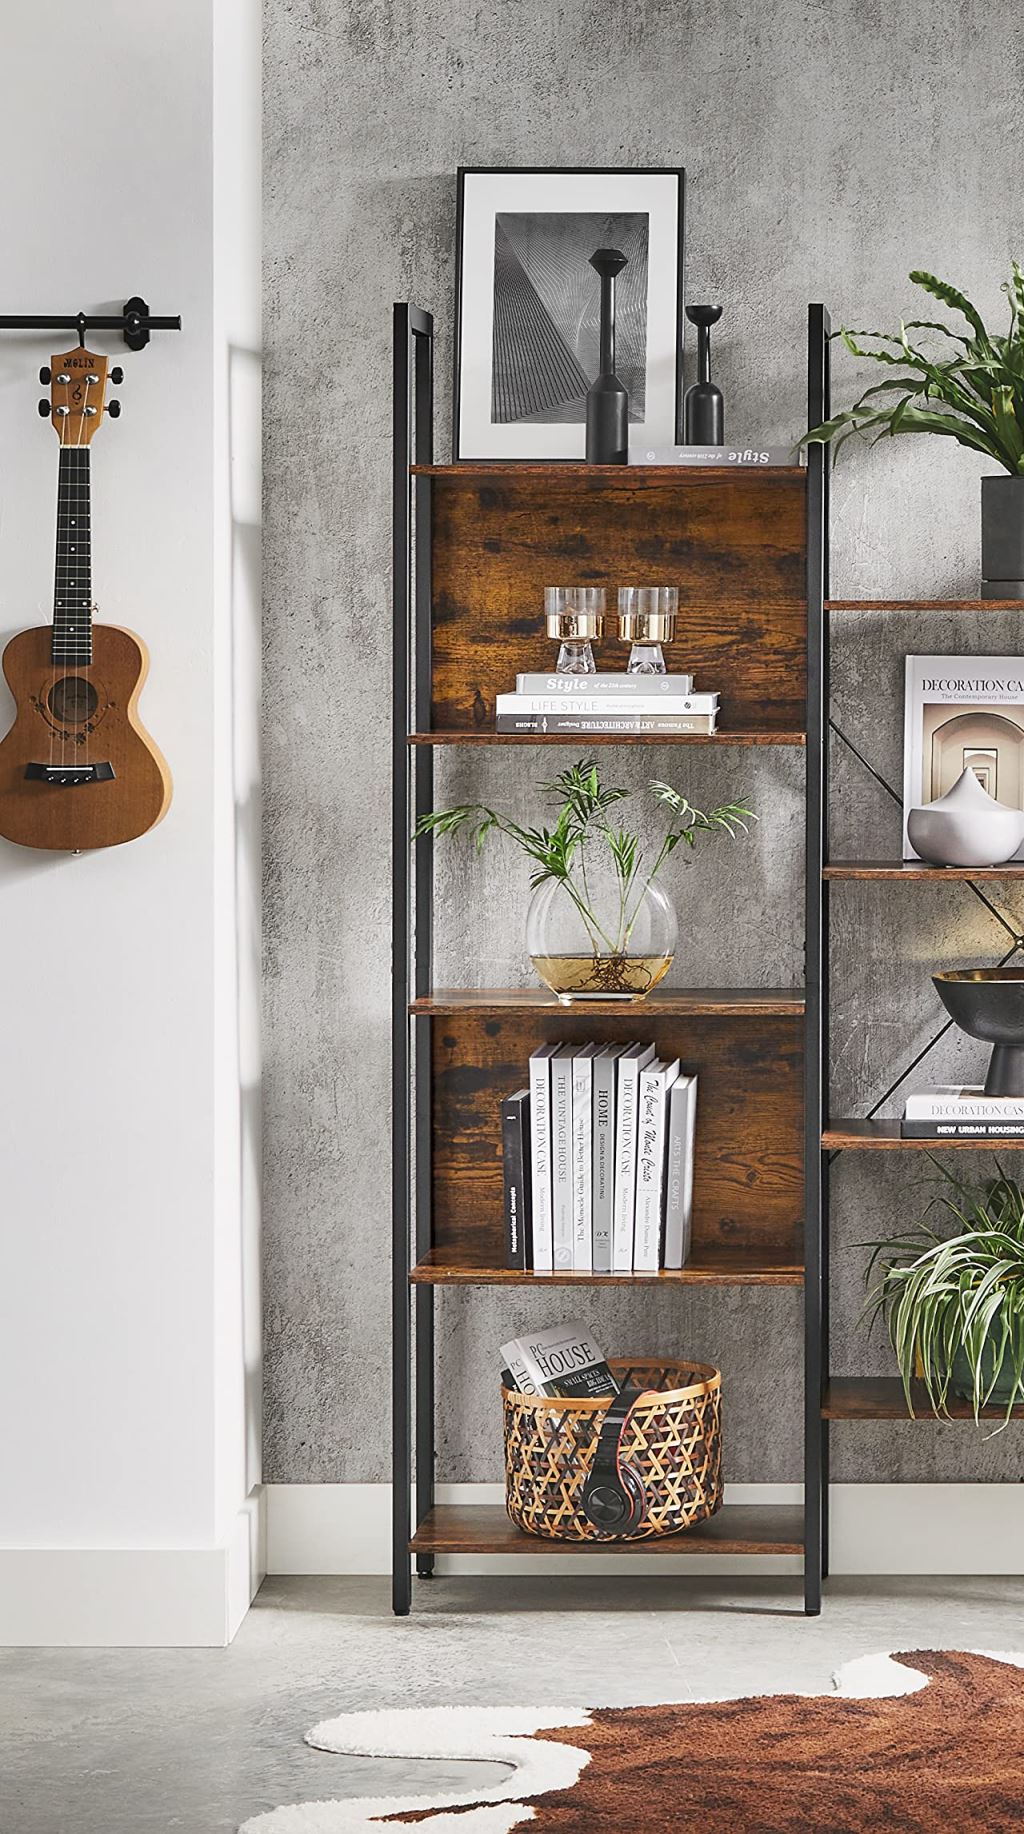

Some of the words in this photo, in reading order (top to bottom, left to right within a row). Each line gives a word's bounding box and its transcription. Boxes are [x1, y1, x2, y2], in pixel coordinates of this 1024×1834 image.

[728, 450, 770, 464] Style
[546, 678, 588, 691] Style
[922, 679, 1004, 692] DECORATION
[530, 701, 557, 712] LIFE
[560, 701, 599, 712] STYLE
[558, 1076, 566, 1096] THE
[646, 1080, 659, 1093] The
[536, 1078, 546, 1148] DECORATION
[598, 1090, 609, 1127] HOME
[622, 1078, 633, 1148] DECORATION
[644, 1094, 658, 1116] Count
[930, 1104, 1002, 1116] DECORATION
[558, 1099, 566, 1145] VINTAGE
[576, 1118, 584, 1140] House
[642, 1118, 656, 1126] of
[937, 1126, 956, 1134] NEW
[958, 1126, 986, 1134] URBAN
[988, 1126, 1024, 1134] HOUSING
[643, 1130, 657, 1156] Monte
[672, 1136, 682, 1156] ARTS
[536, 1150, 547, 1177] CASE
[558, 1148, 567, 1183] HOUSE
[577, 1164, 584, 1172] to
[621, 1150, 632, 1177] CASE
[672, 1160, 681, 1176] THE
[577, 1174, 585, 1194] Guide
[671, 1179, 680, 1210] CRAFTS
[577, 1228, 585, 1242] The
[530, 1344, 546, 1358] PC
[536, 1342, 596, 1378] HOUSE
[510, 1359, 521, 1370] PC
